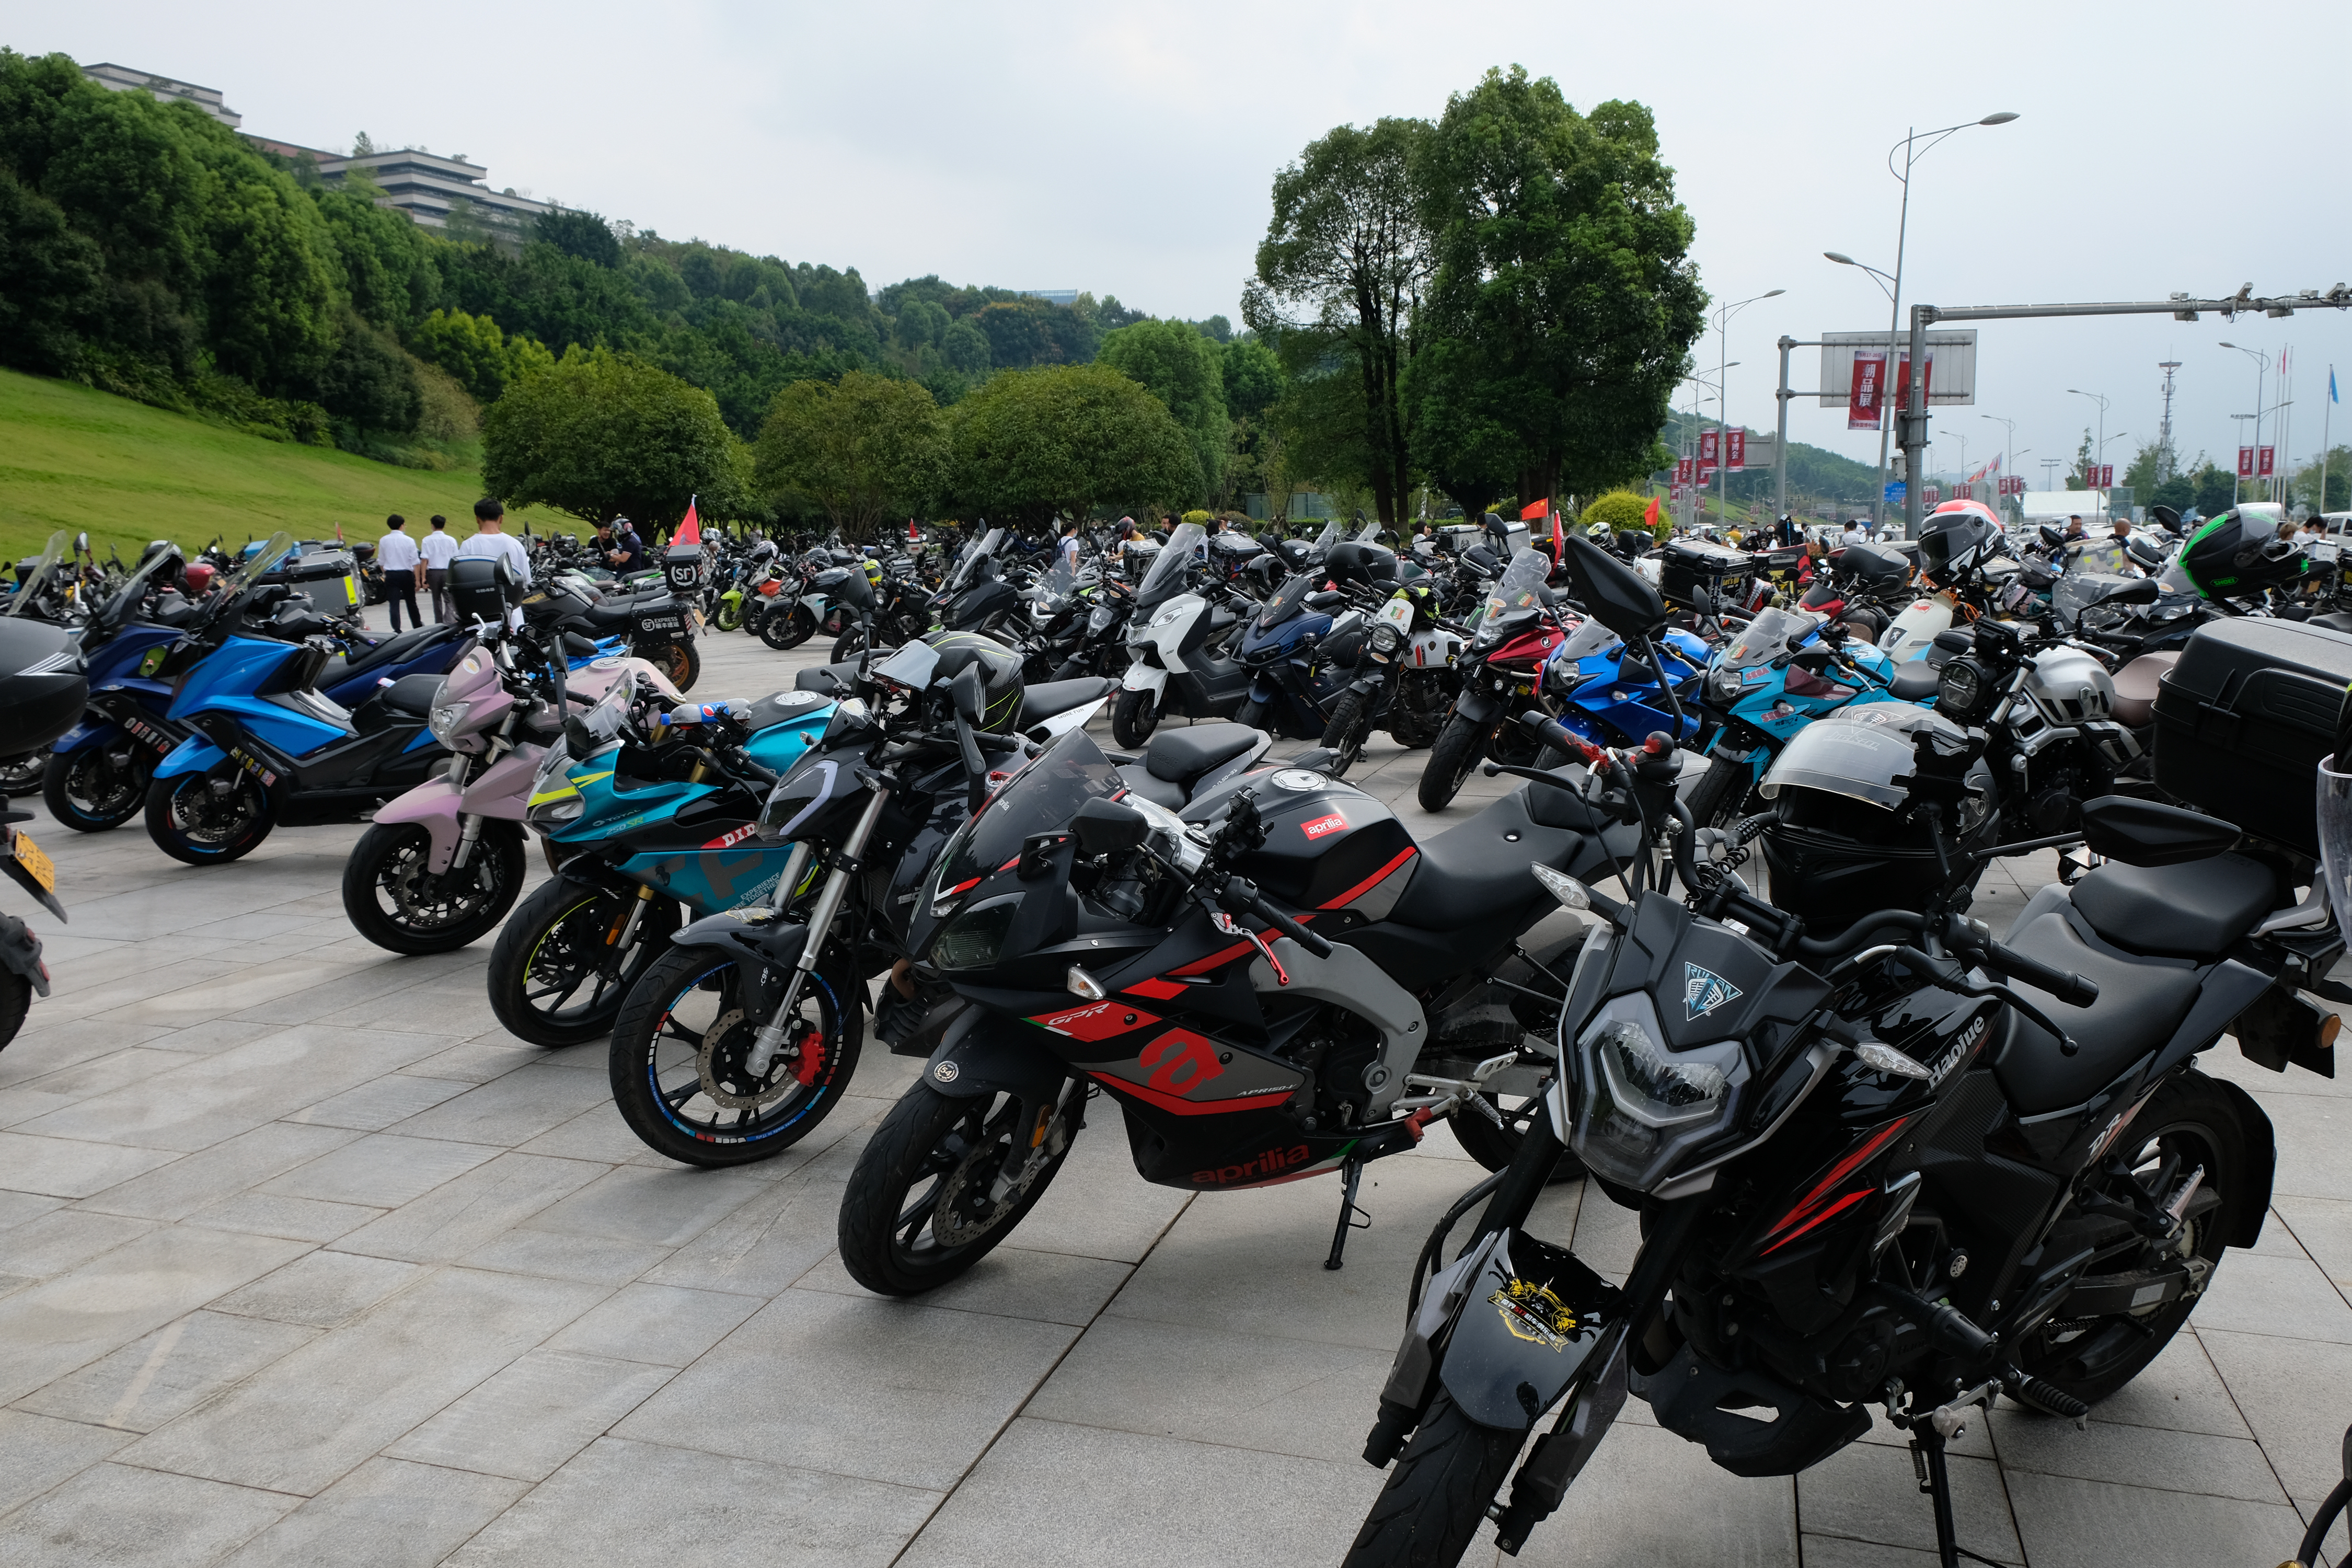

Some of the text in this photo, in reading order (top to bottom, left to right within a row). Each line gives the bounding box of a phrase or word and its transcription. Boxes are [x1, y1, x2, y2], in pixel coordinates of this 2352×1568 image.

[1859, 363, 1876, 407] 潮品展
[2213, 578, 2235, 586] SHOEI
[1745, 666, 1770, 681] SEGA
[1057, 711, 1073, 719] MORE
[605, 809, 641, 822] TOTAL
[606, 816, 644, 835] 250 SR
[1308, 817, 1343, 834] aprilia
[740, 871, 781, 901] EXPERIENCE
[1048, 1002, 1110, 1025] GPR
[1928, 1016, 1985, 1089] Haojue
[940, 1066, 952, 1076] 54
[1237, 1083, 1297, 1097] APR150-V
[1192, 1144, 1310, 1184] aprilia
